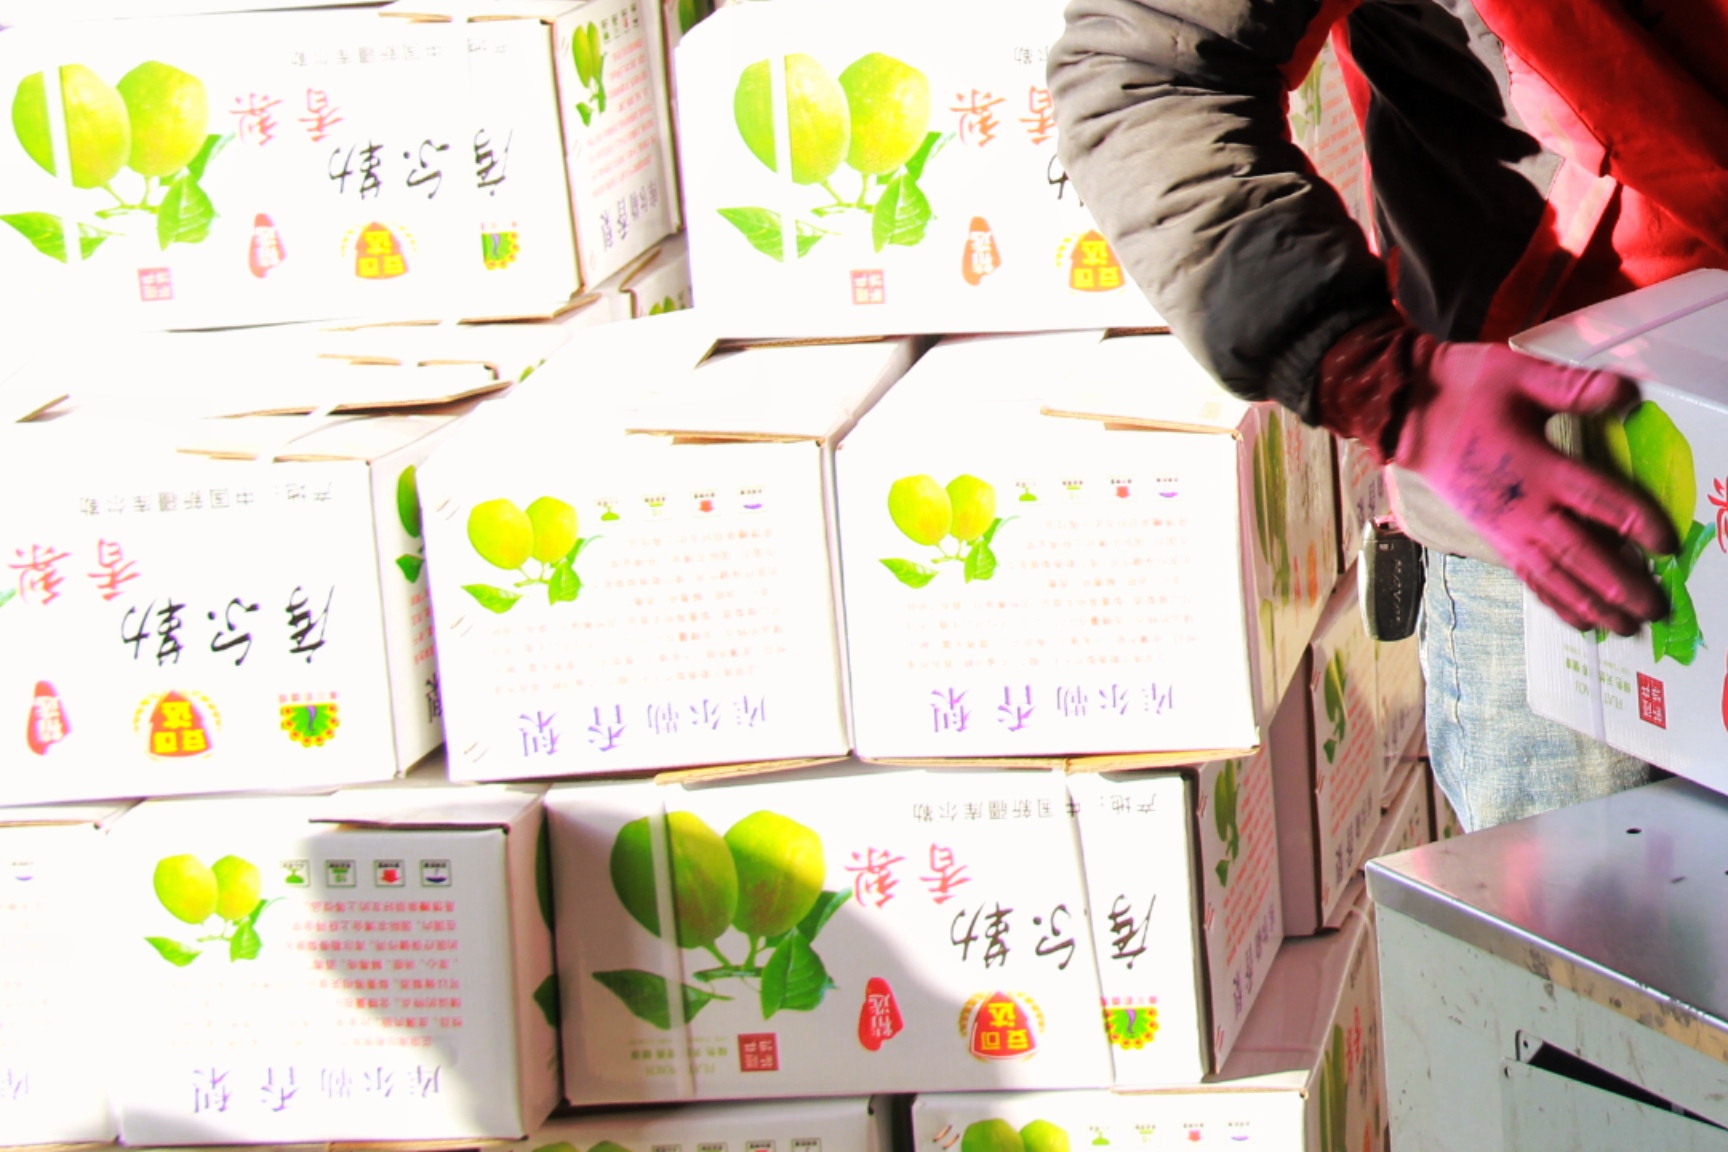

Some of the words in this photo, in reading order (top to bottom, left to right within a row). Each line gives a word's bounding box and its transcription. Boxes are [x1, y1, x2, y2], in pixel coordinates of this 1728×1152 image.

[228, 87, 343, 145] 香梨
[948, 84, 1055, 147] 香梨
[327, 127, 511, 198] 库尔勒
[5, 537, 141, 605] 香梨
[120, 584, 333, 666] 库尔勒
[927, 679, 1174, 732] 库尔勒香梨
[842, 842, 970, 908] 香梨
[949, 893, 1155, 969] 库尔勒
[867, 992, 892, 1037] 精选
[981, 1001, 1027, 1049] 安可达
[191, 1063, 440, 1113] 库尔勒香梨
